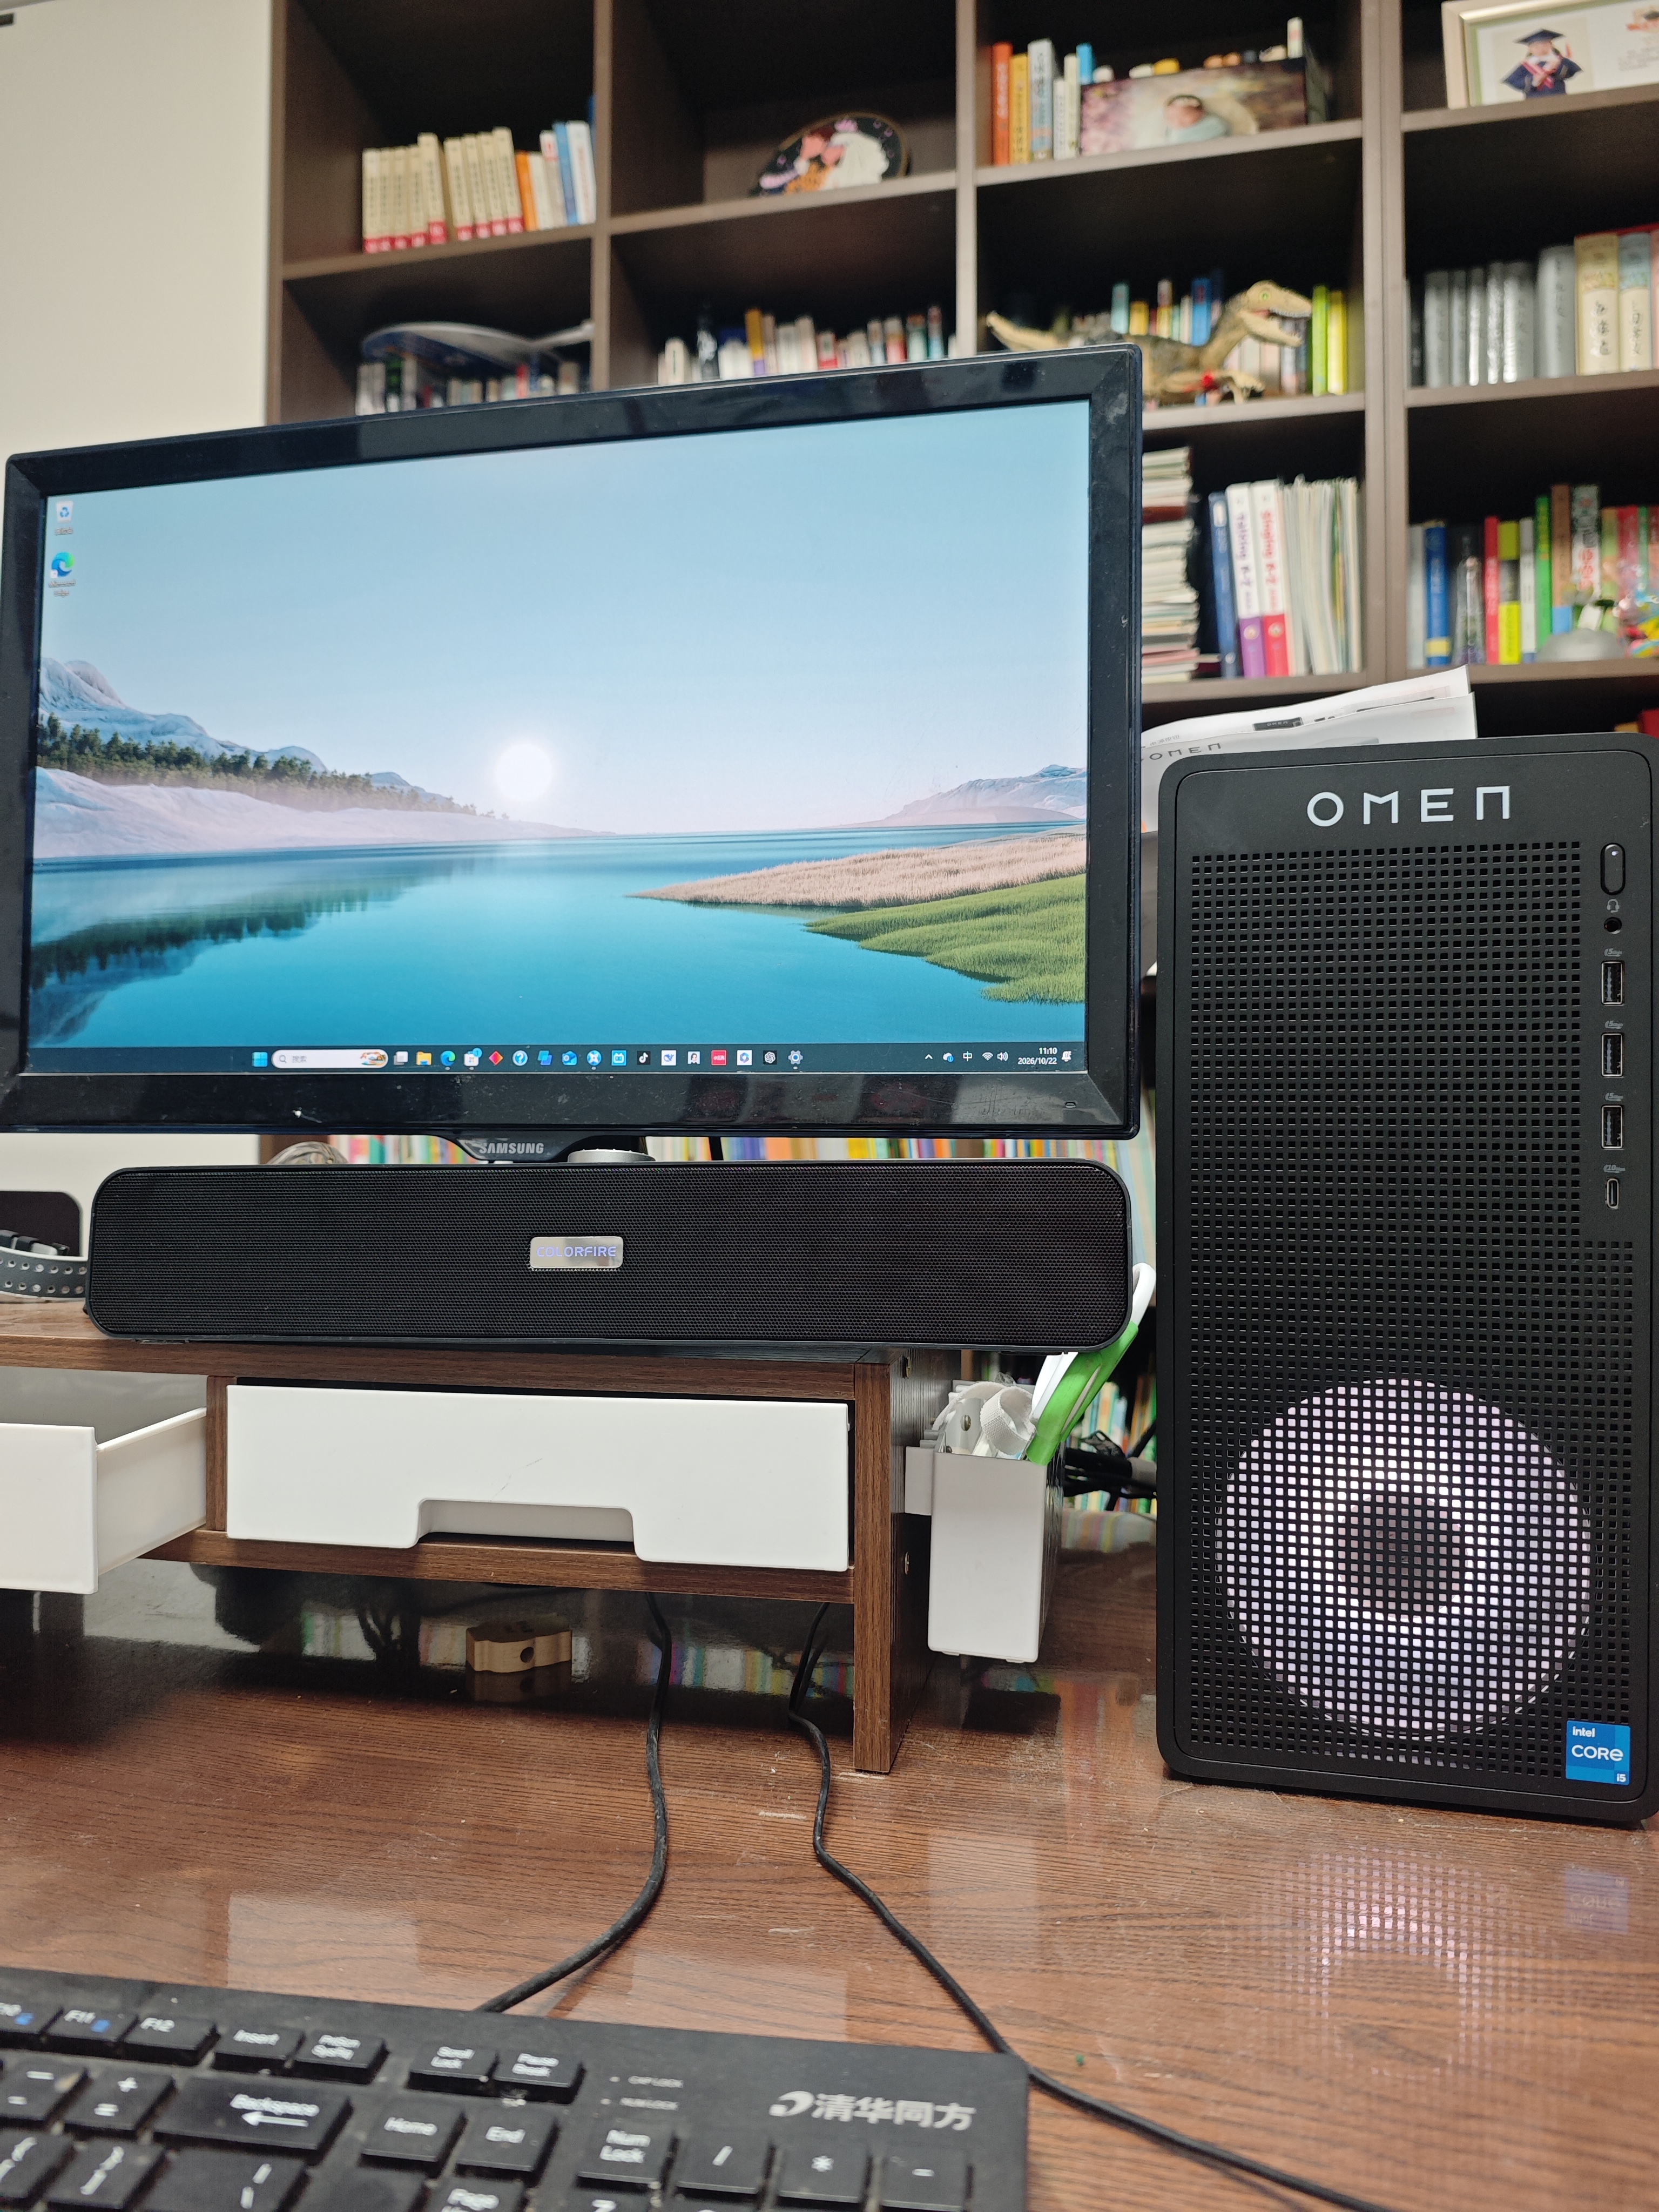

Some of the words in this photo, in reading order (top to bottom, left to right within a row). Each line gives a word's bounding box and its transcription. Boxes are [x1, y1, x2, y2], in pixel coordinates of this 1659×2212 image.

[1149, 743, 1222, 760] OMEN
[1307, 785, 1511, 827] OMEN
[963, 1051, 973, 1062] 中
[1017, 1057, 1057, 1065] 2026/10/22
[479, 1143, 544, 1155] SAMSUNG
[536, 1246, 616, 1257] COLORFIRE
[1572, 1726, 1595, 1737] intel
[1616, 1773, 1627, 1782] i5
[811, 2094, 976, 2130] 清华同方
[384, 2116, 439, 2136] Home
[486, 2126, 526, 2143] End
[606, 2129, 651, 2148] Num
[599, 2145, 646, 2163] Lock
